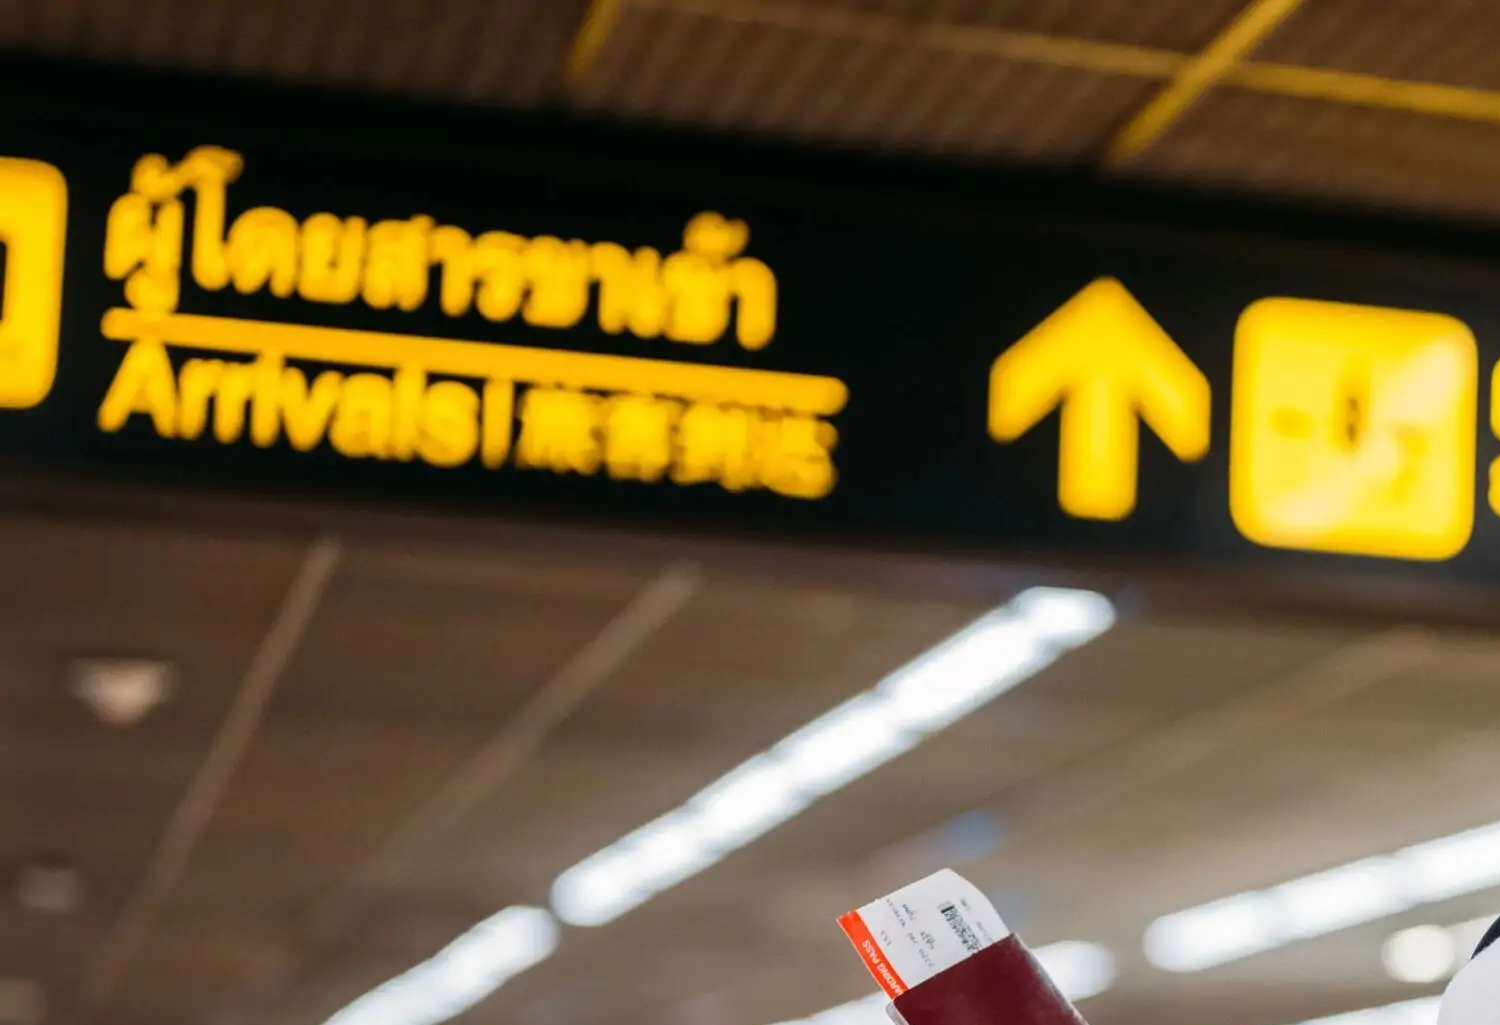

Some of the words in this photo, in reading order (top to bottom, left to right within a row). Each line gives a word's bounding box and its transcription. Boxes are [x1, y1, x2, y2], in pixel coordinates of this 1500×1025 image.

[97, 337, 480, 468] Arrivals
[862, 939, 881, 965] PASS
[877, 962, 904, 996] ARDING
